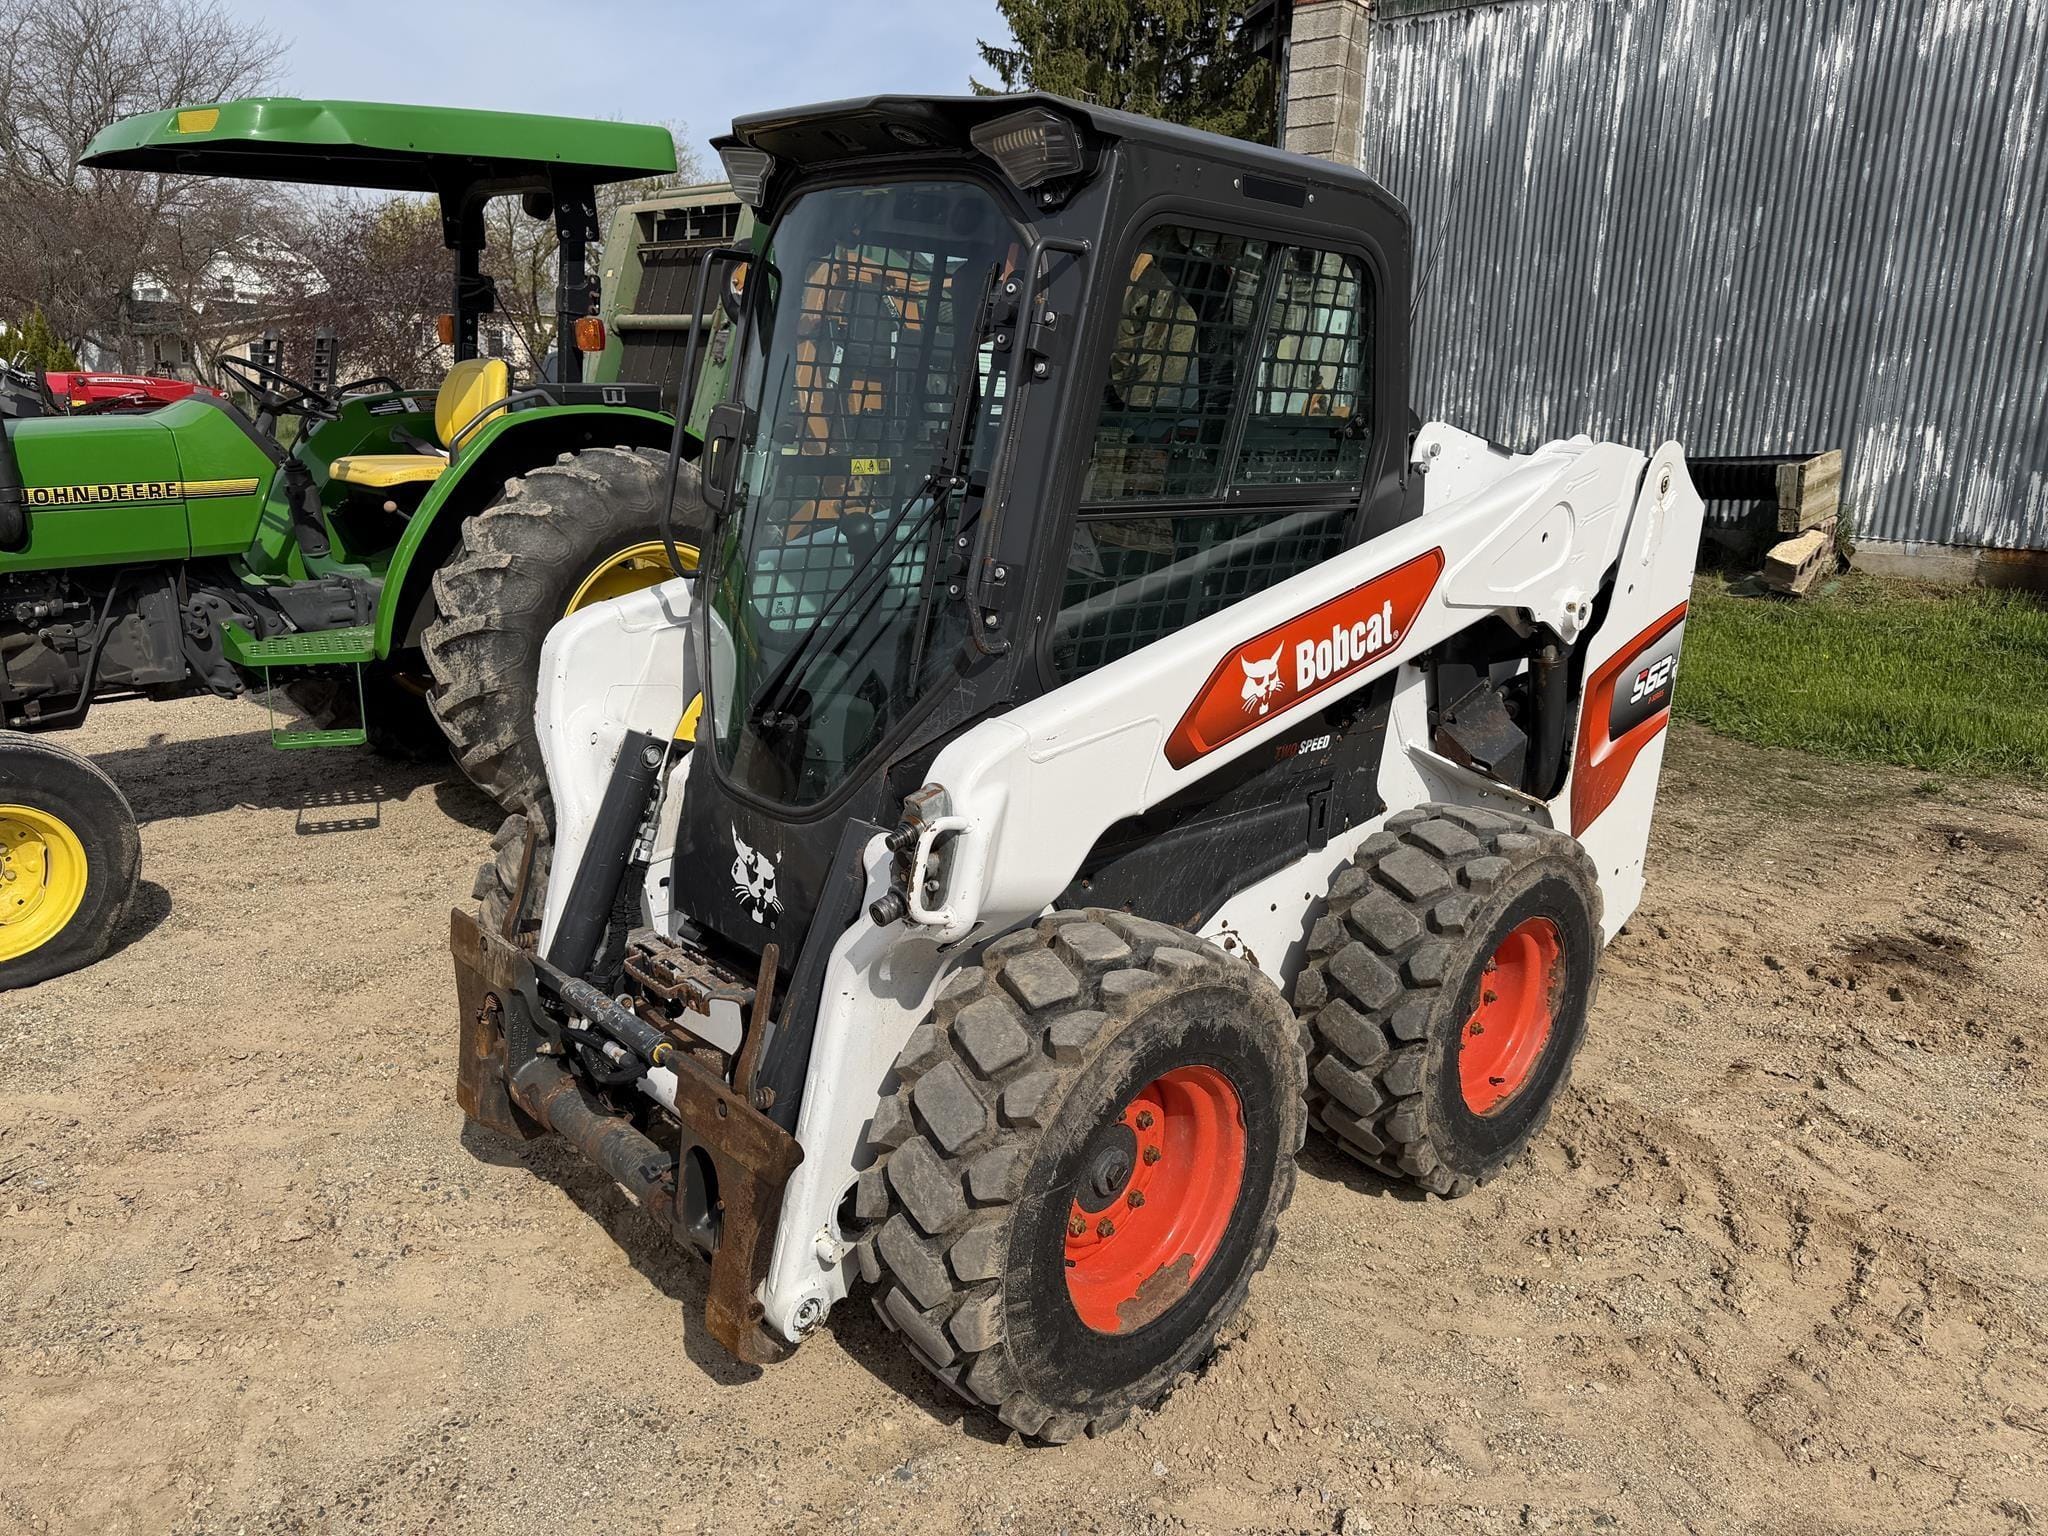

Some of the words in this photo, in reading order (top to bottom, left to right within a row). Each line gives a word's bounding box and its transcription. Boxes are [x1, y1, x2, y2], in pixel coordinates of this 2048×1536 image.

[98, 482, 178, 501] DEERE
[1296, 600, 1392, 691] Bobcat
[1299, 734, 1331, 755] SPEED
